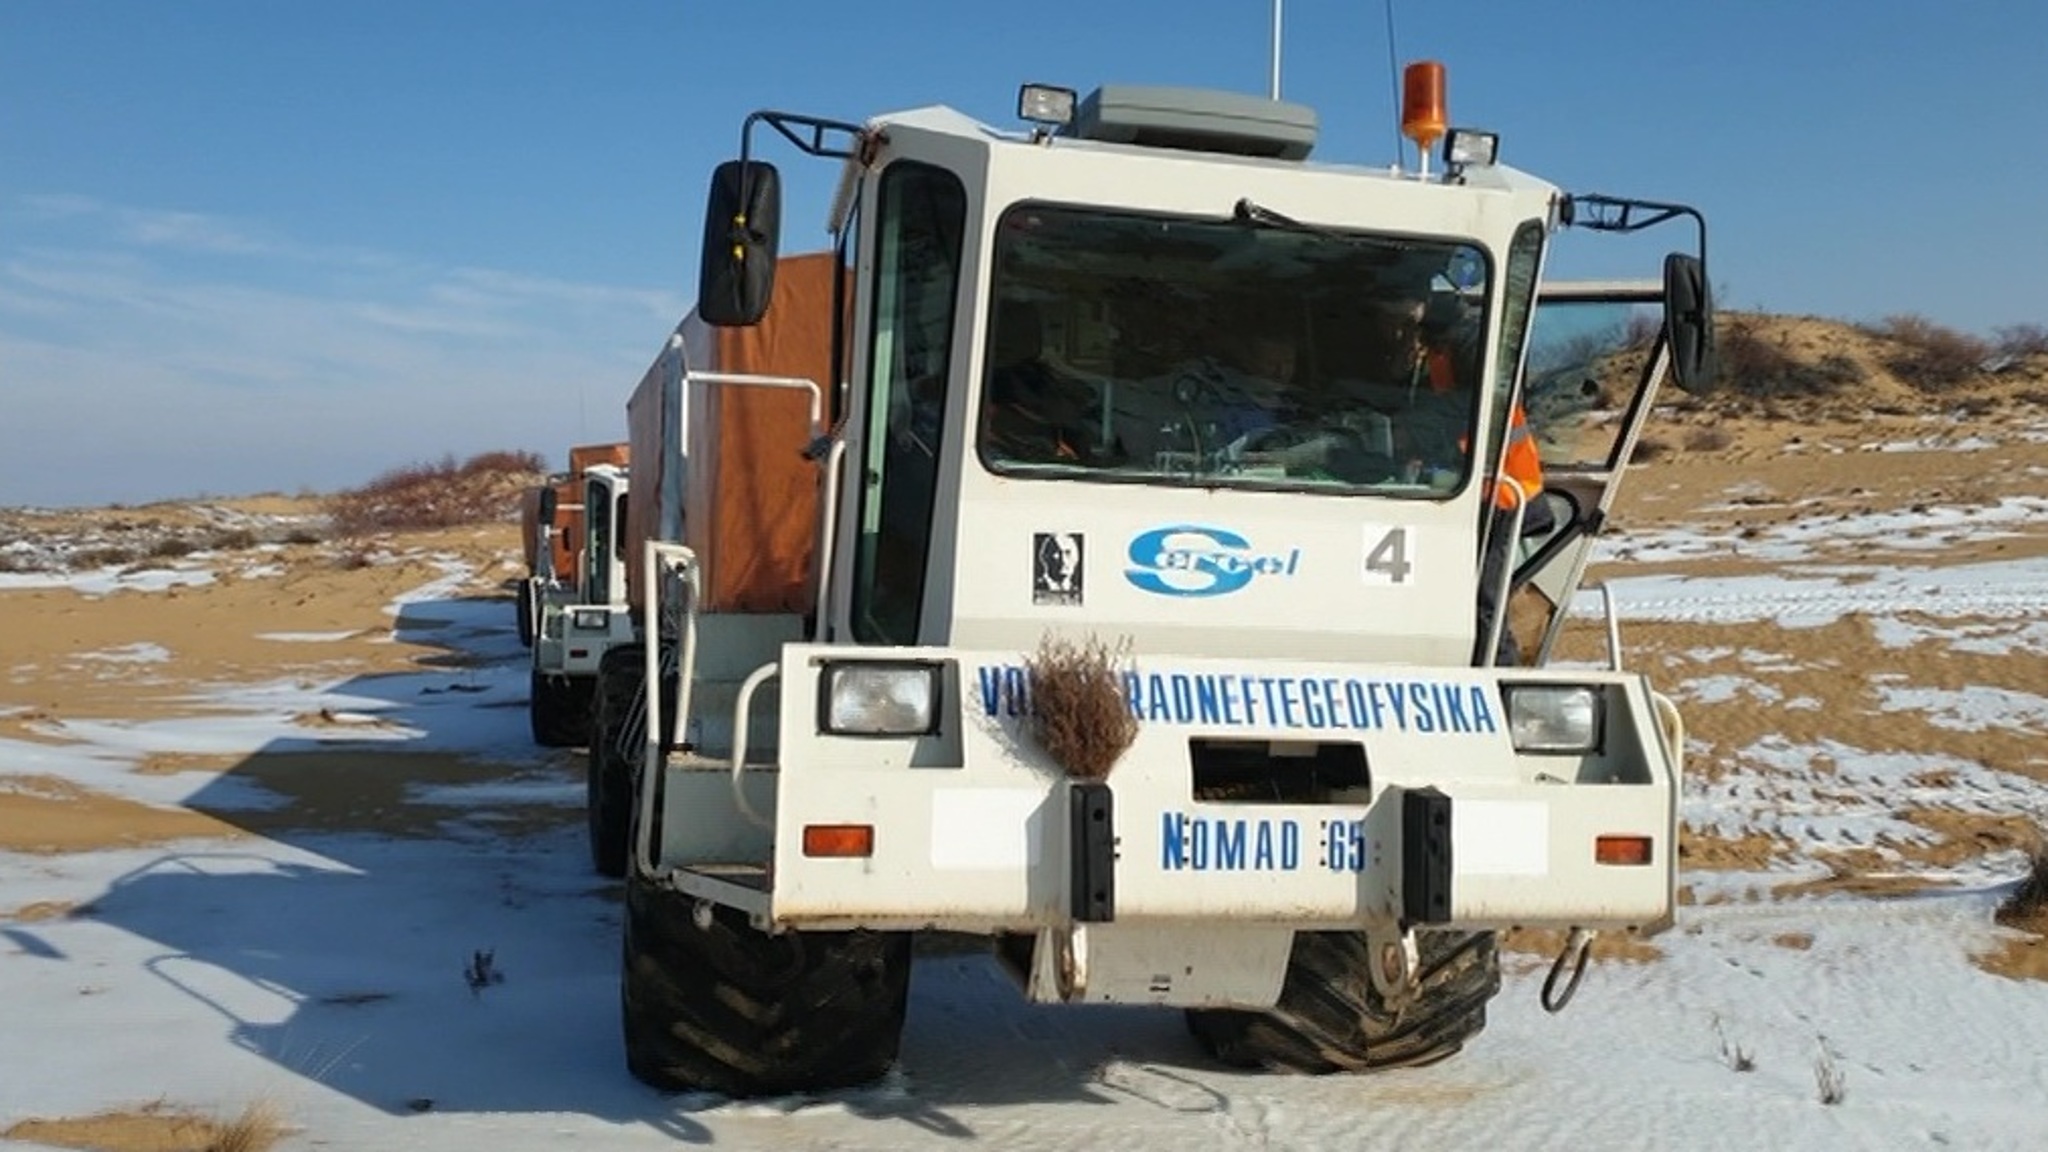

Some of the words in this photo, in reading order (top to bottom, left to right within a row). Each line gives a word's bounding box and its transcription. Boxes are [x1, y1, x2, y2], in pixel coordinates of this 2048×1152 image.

[1365, 528, 1411, 583] 4
[978, 665, 1497, 734] VORADNEFTEGEOFYSIKA
[1162, 812, 1298, 871] NOMAD
[1328, 819, 1366, 872] 65
